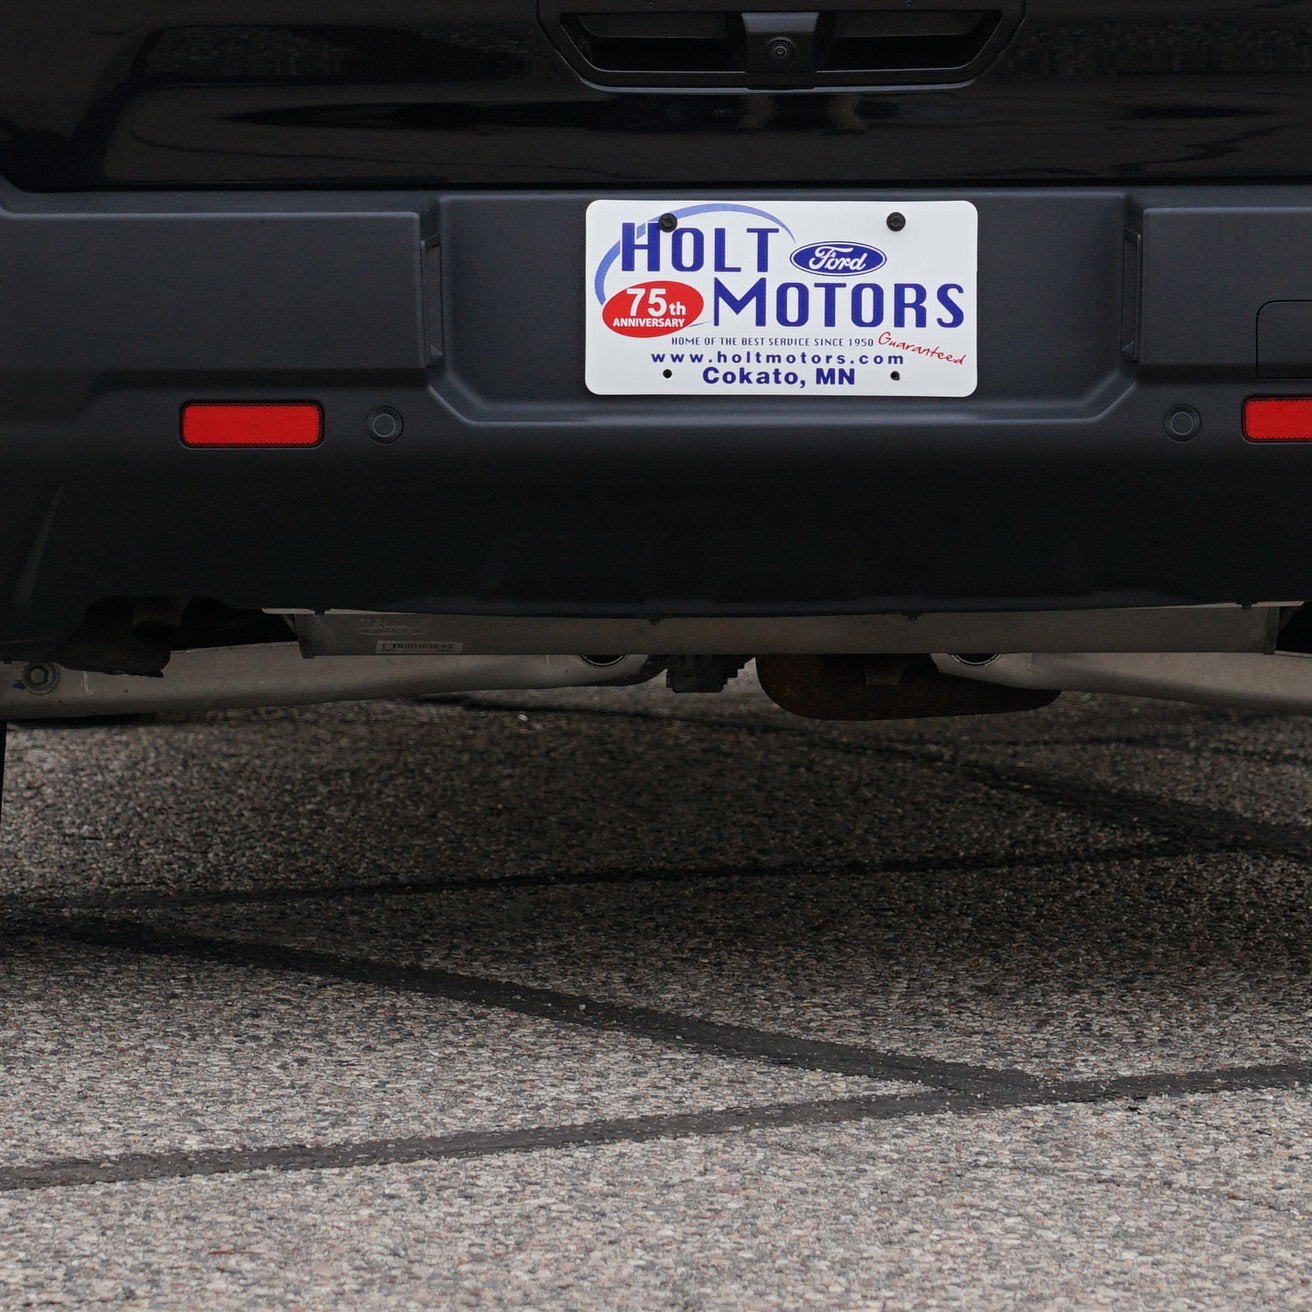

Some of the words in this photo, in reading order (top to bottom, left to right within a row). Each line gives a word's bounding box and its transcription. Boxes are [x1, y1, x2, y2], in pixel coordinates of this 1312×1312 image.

[621, 222, 780, 273] HOLT
[808, 244, 869, 272] Ford
[626, 288, 687, 317] 75th
[713, 277, 965, 329] MOTORS
[612, 317, 686, 328] ANNIVERSARY
[671, 336, 701, 346] HOME
[704, 336, 716, 346] OF
[719, 336, 738, 346] THE
[741, 337, 765, 346] BEST
[768, 337, 810, 347] SERVICE
[814, 337, 844, 347] SINCE
[848, 338, 875, 347] 1950
[877, 331, 967, 365] Guaranteed
[651, 351, 904, 365] www.holtmotors.com
[702, 366, 807, 389] Cokato,
[815, 368, 855, 385] MN
